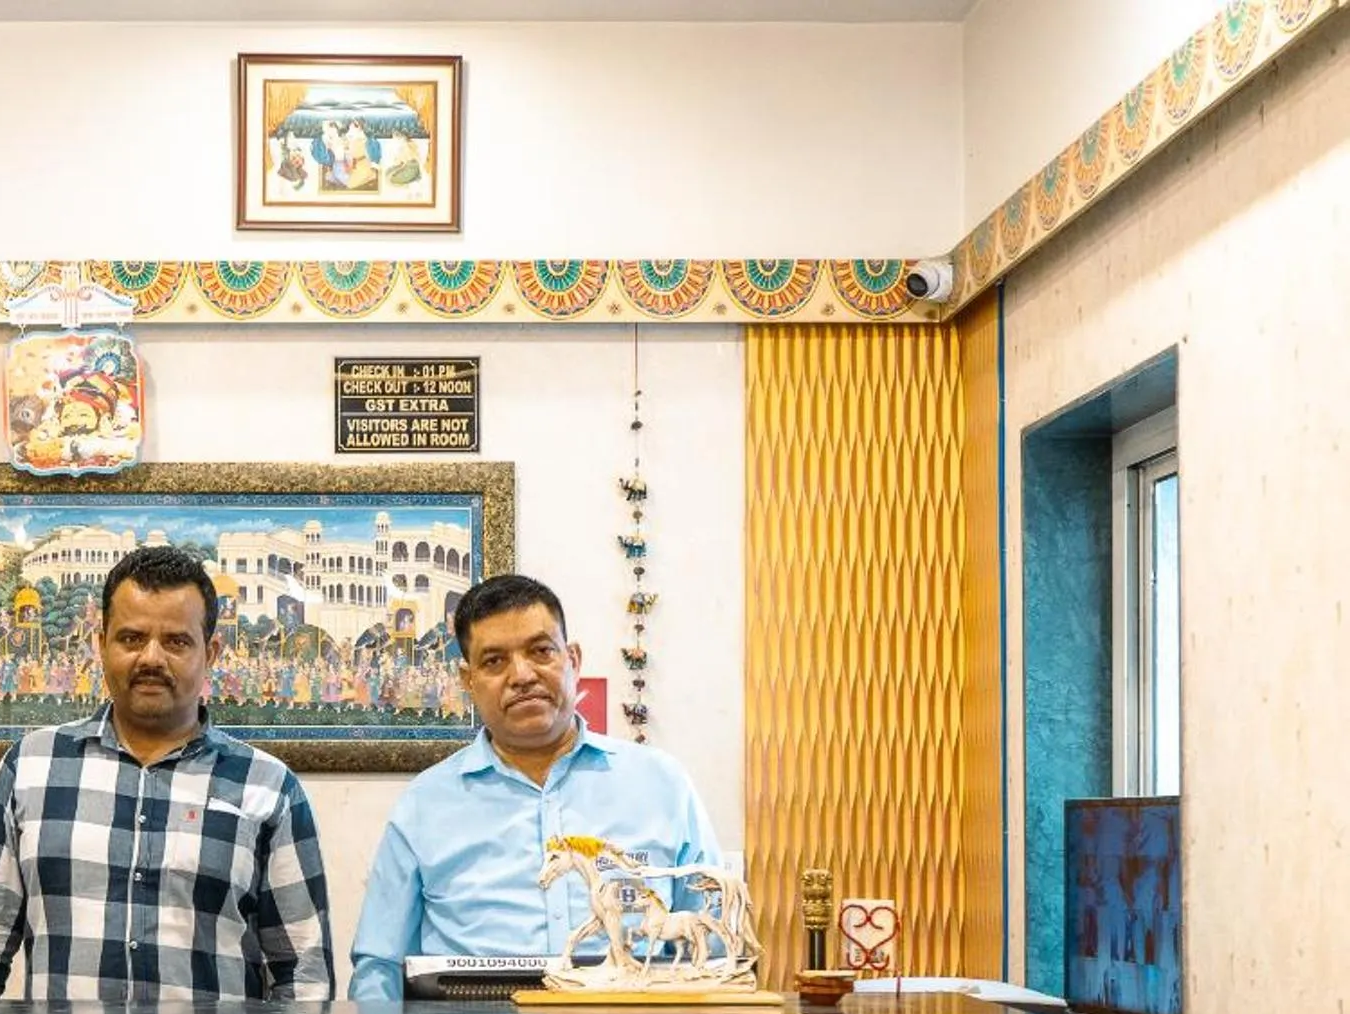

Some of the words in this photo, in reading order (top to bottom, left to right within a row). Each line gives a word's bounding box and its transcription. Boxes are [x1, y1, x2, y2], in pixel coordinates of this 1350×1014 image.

[351, 365, 390, 378] CHECK
[392, 365, 405, 378] IN
[422, 364, 435, 378] 01
[343, 381, 382, 394] CHECK
[384, 381, 408, 394] OUT
[423, 381, 437, 394] 12
[438, 381, 472, 394] NOON
[365, 399, 395, 412] GST
[399, 399, 449, 412] EXTRA
[346, 418, 407, 432] VISITORS
[411, 418, 438, 432] ARE
[441, 418, 469, 432] NOT
[346, 433, 409, 447] ALLOWED
[413, 433, 427, 447] IN
[430, 433, 470, 447] ROOM
